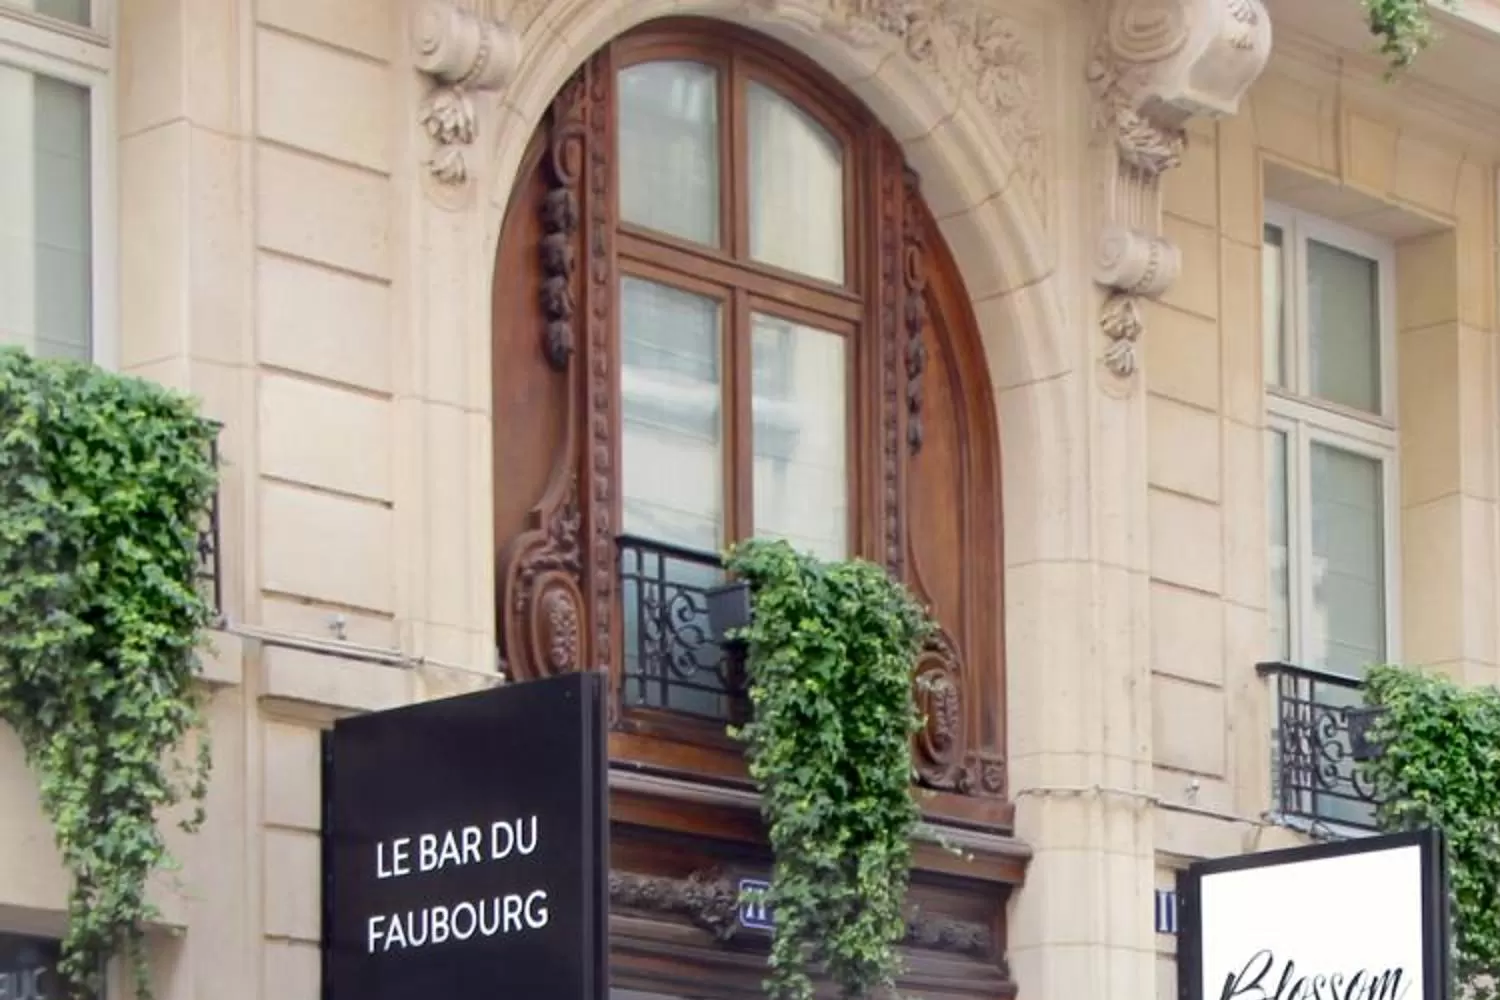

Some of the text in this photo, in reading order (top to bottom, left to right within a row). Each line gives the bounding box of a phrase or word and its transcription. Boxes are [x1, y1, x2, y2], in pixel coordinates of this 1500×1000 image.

[377, 815, 537, 878] LE BAR DU
[368, 889, 549, 953] FAUBOURG
